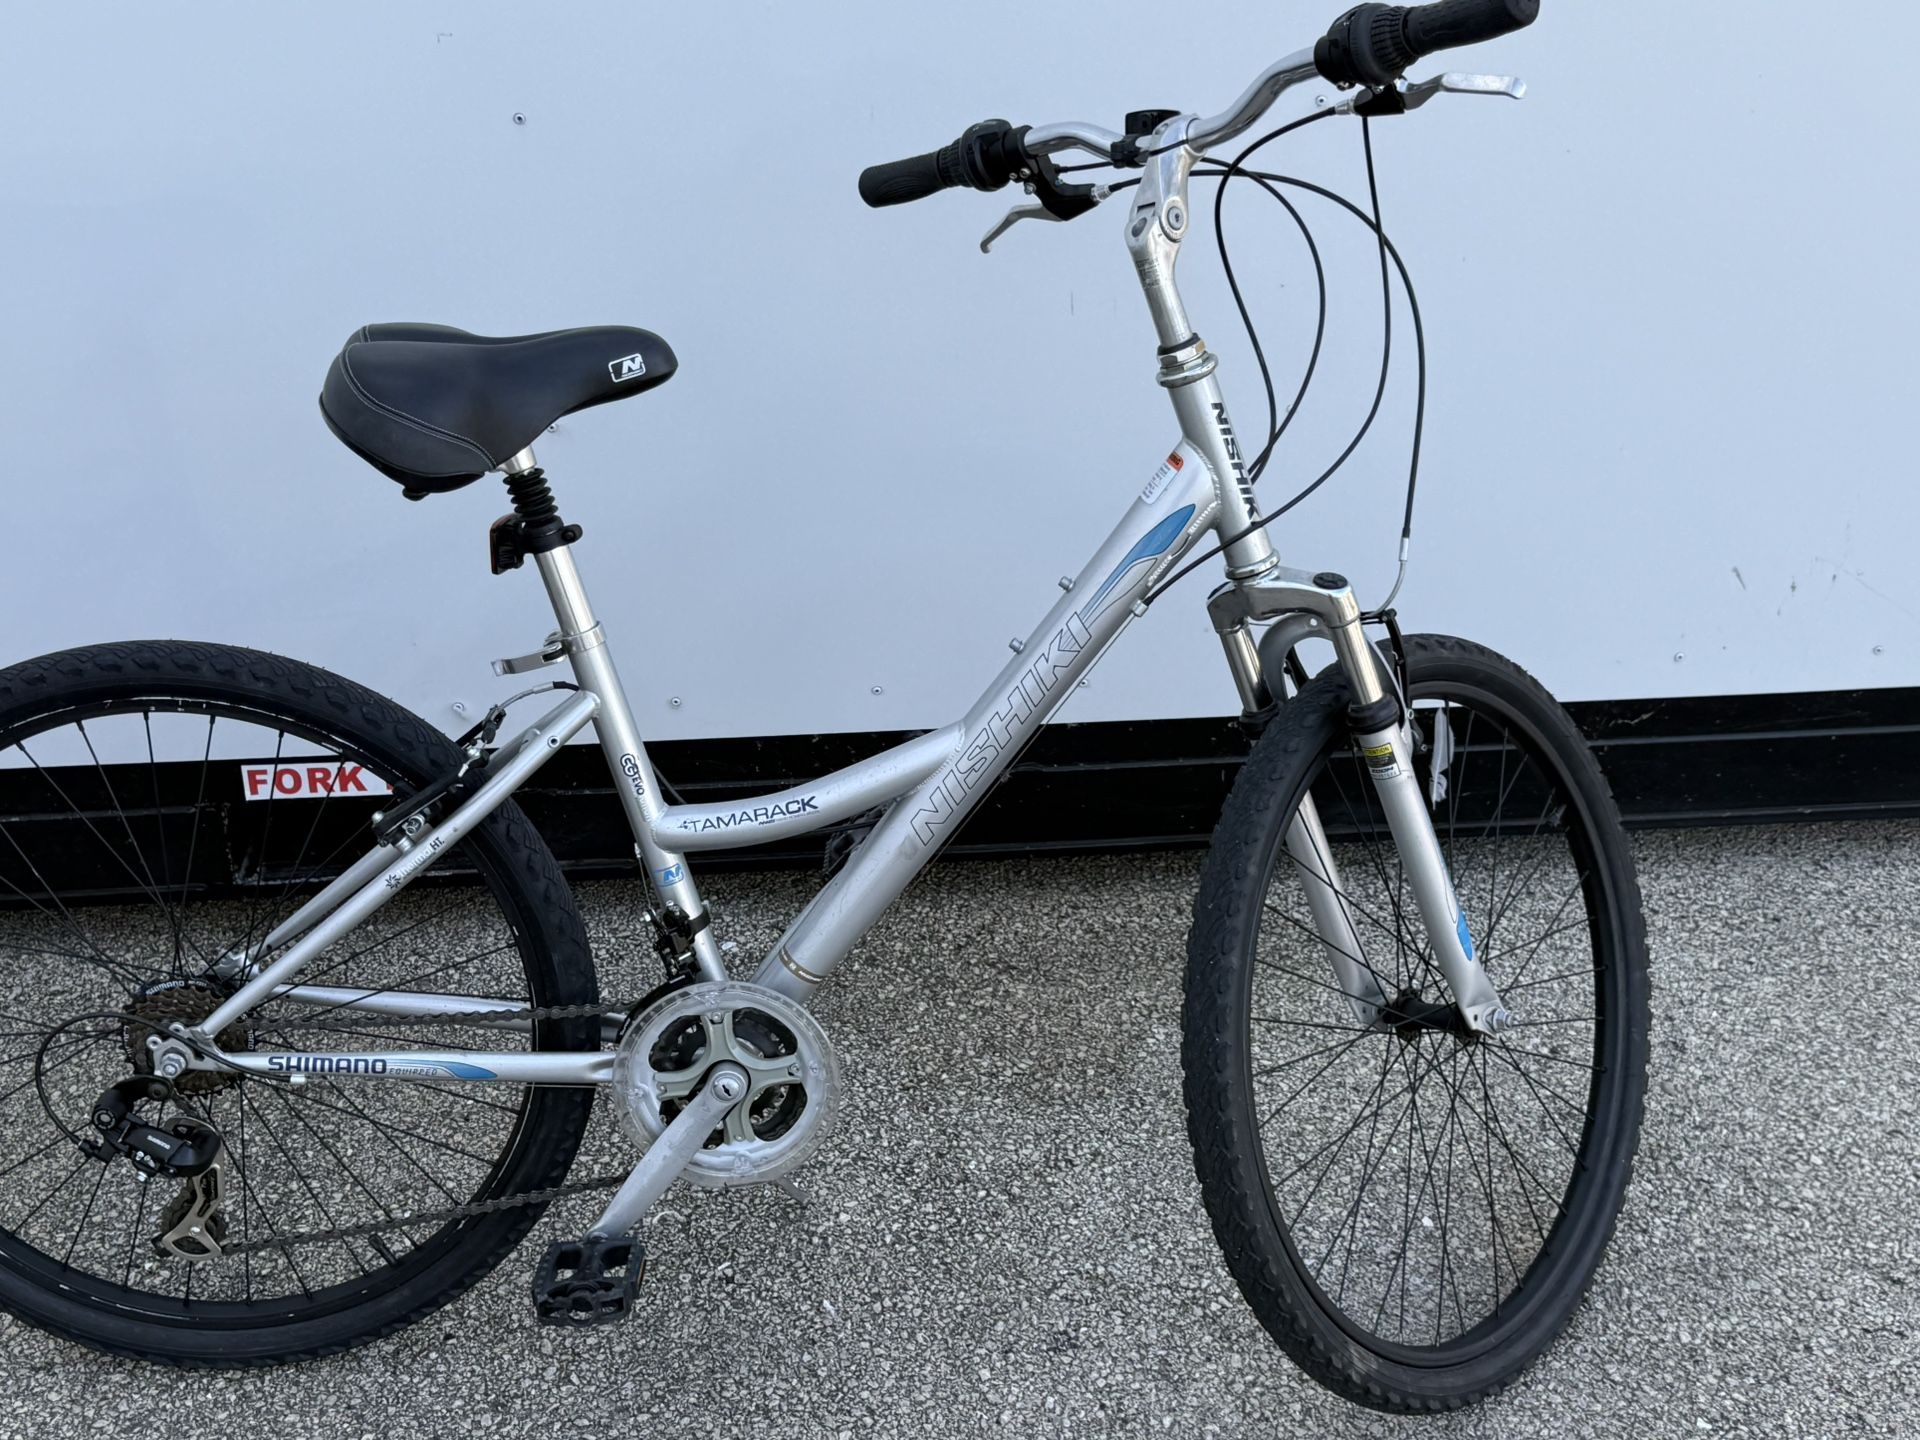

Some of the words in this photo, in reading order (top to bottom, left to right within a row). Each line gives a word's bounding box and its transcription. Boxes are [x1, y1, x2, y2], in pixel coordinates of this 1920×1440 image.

[910, 611, 1093, 847] NISHIKI
[246, 766, 368, 796] FORK
[690, 795, 819, 833] TAMARACK
[145, 980, 185, 996] SHIMANO
[267, 1056, 387, 1075] SHIMANO
[389, 1067, 438, 1076] EQUIPPED
